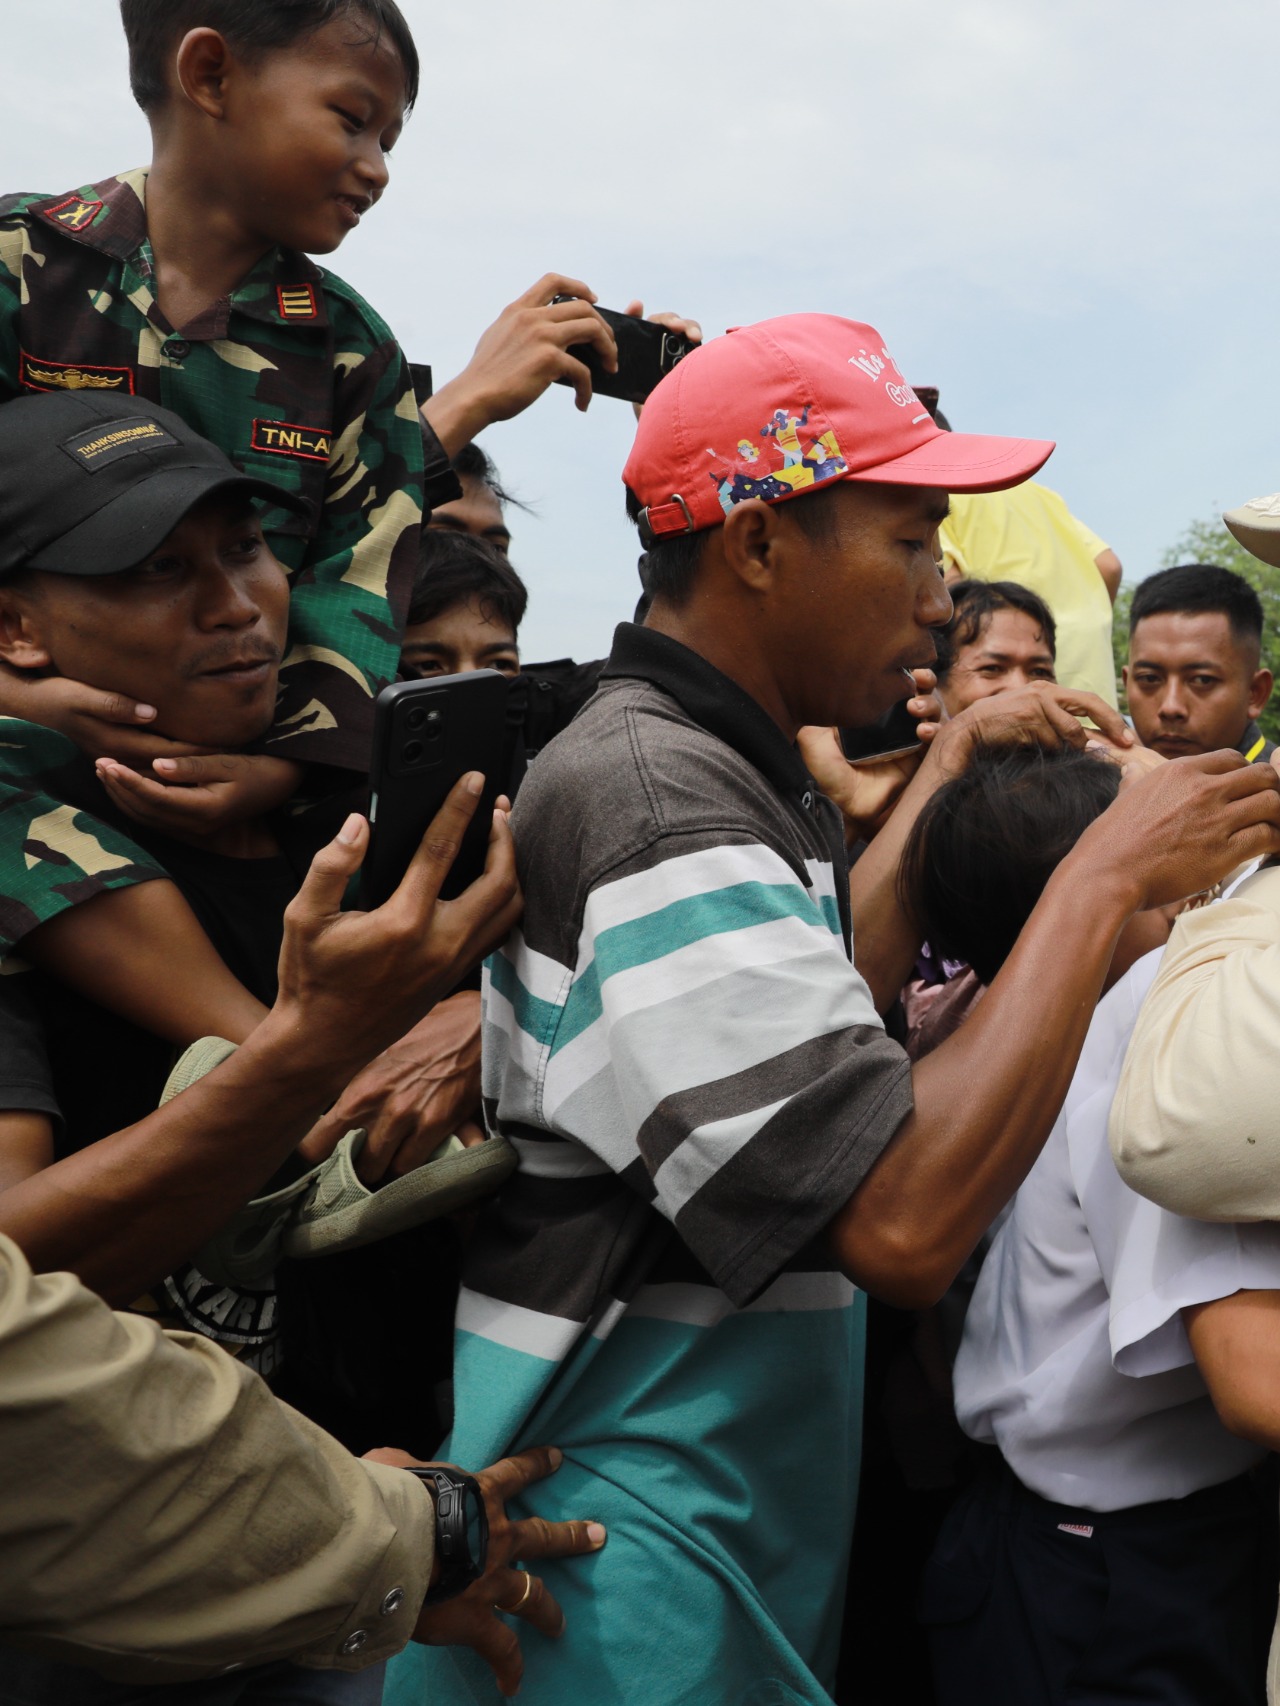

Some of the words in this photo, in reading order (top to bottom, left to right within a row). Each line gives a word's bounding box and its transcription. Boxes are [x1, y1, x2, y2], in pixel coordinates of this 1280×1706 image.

[848, 349, 885, 382] It's
[77, 425, 158, 455] THANKSINSOMNIA
[261, 427, 331, 455] TNI-A
